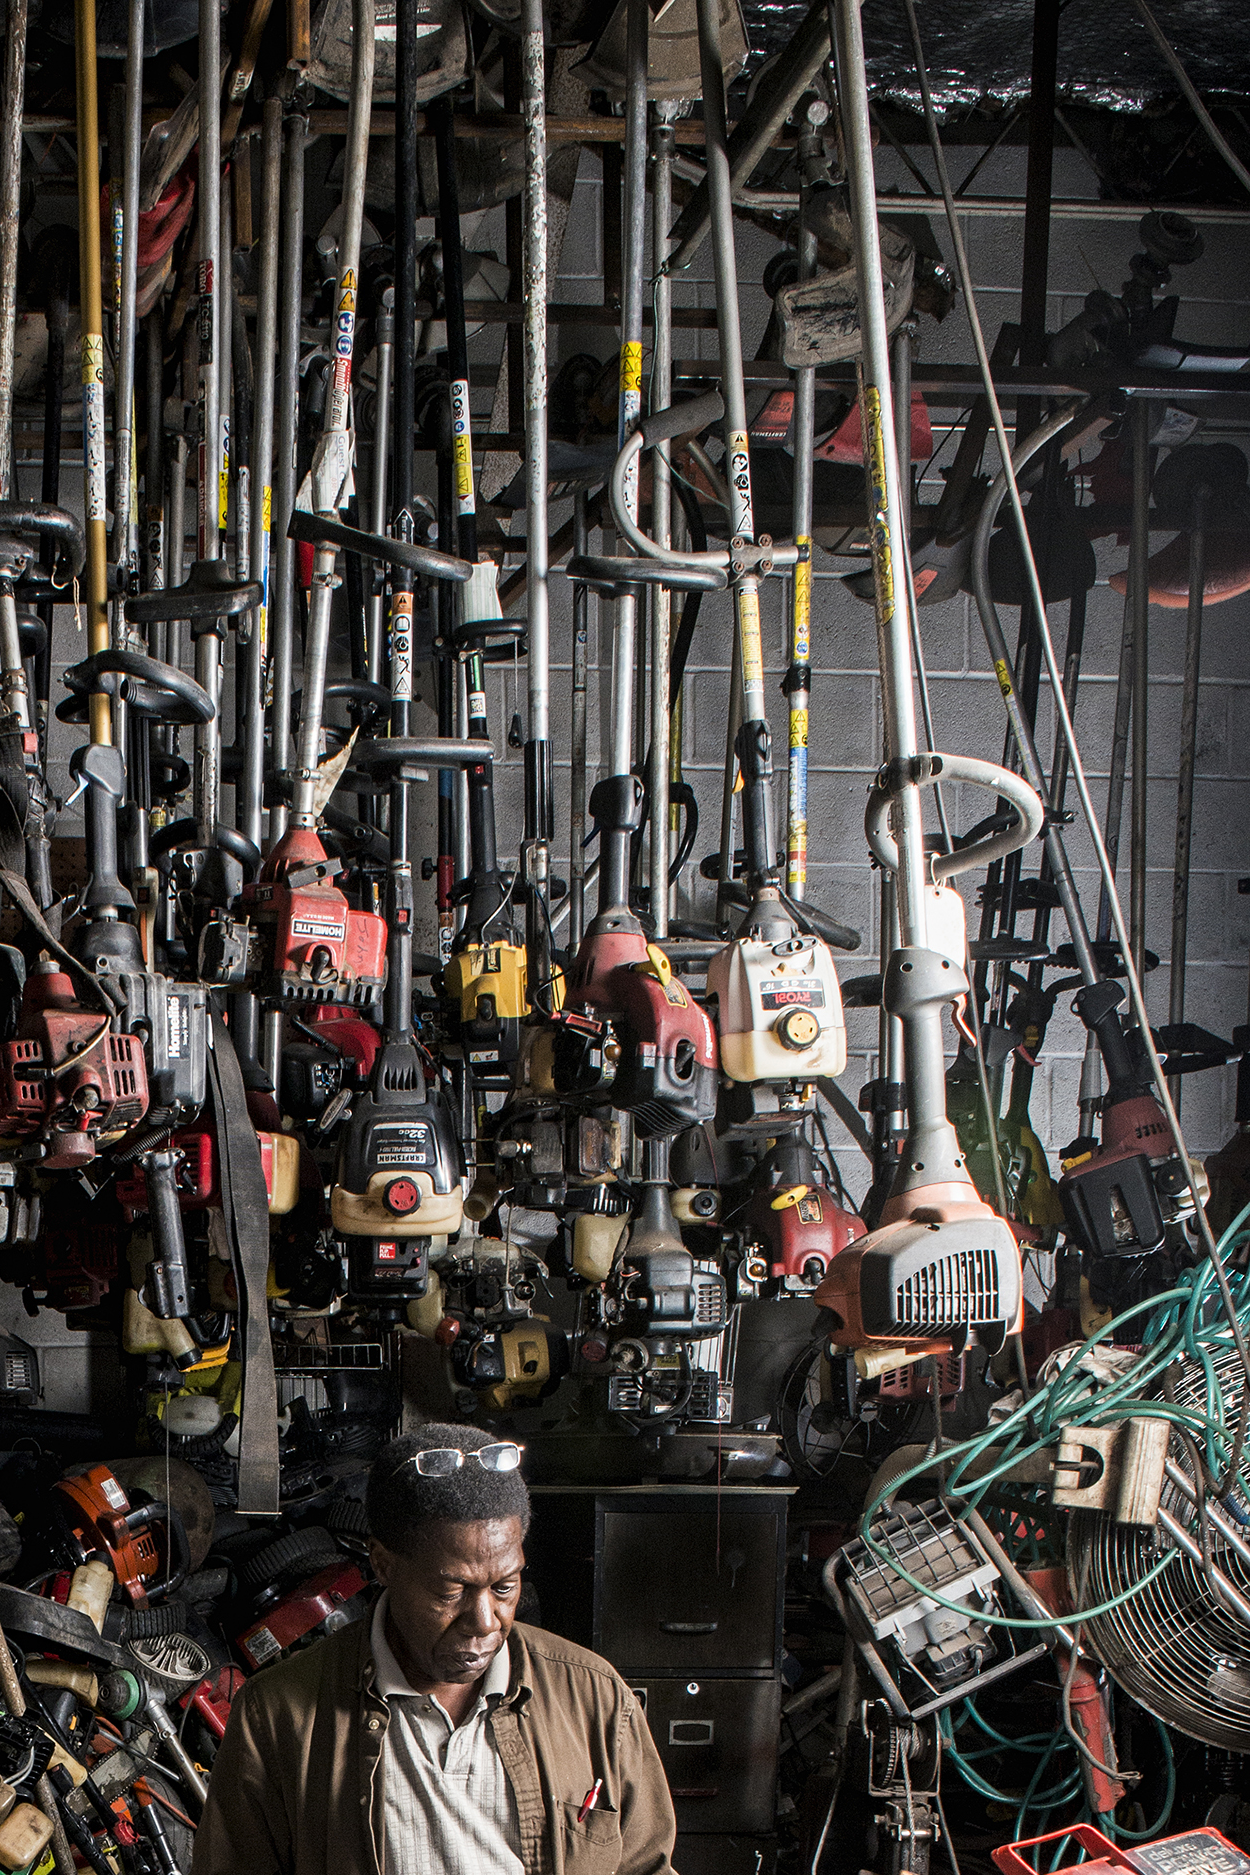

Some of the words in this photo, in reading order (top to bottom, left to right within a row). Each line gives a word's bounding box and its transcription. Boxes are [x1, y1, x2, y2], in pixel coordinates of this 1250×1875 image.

[200, 261, 208, 293] TORO
[338, 436, 347, 468] Guest
[294, 922, 343, 939] HOMELITE
[167, 996, 181, 1058] Homelite
[398, 1128, 427, 1138] 32cc
[378, 1154, 426, 1164] CRAFTSMAN
